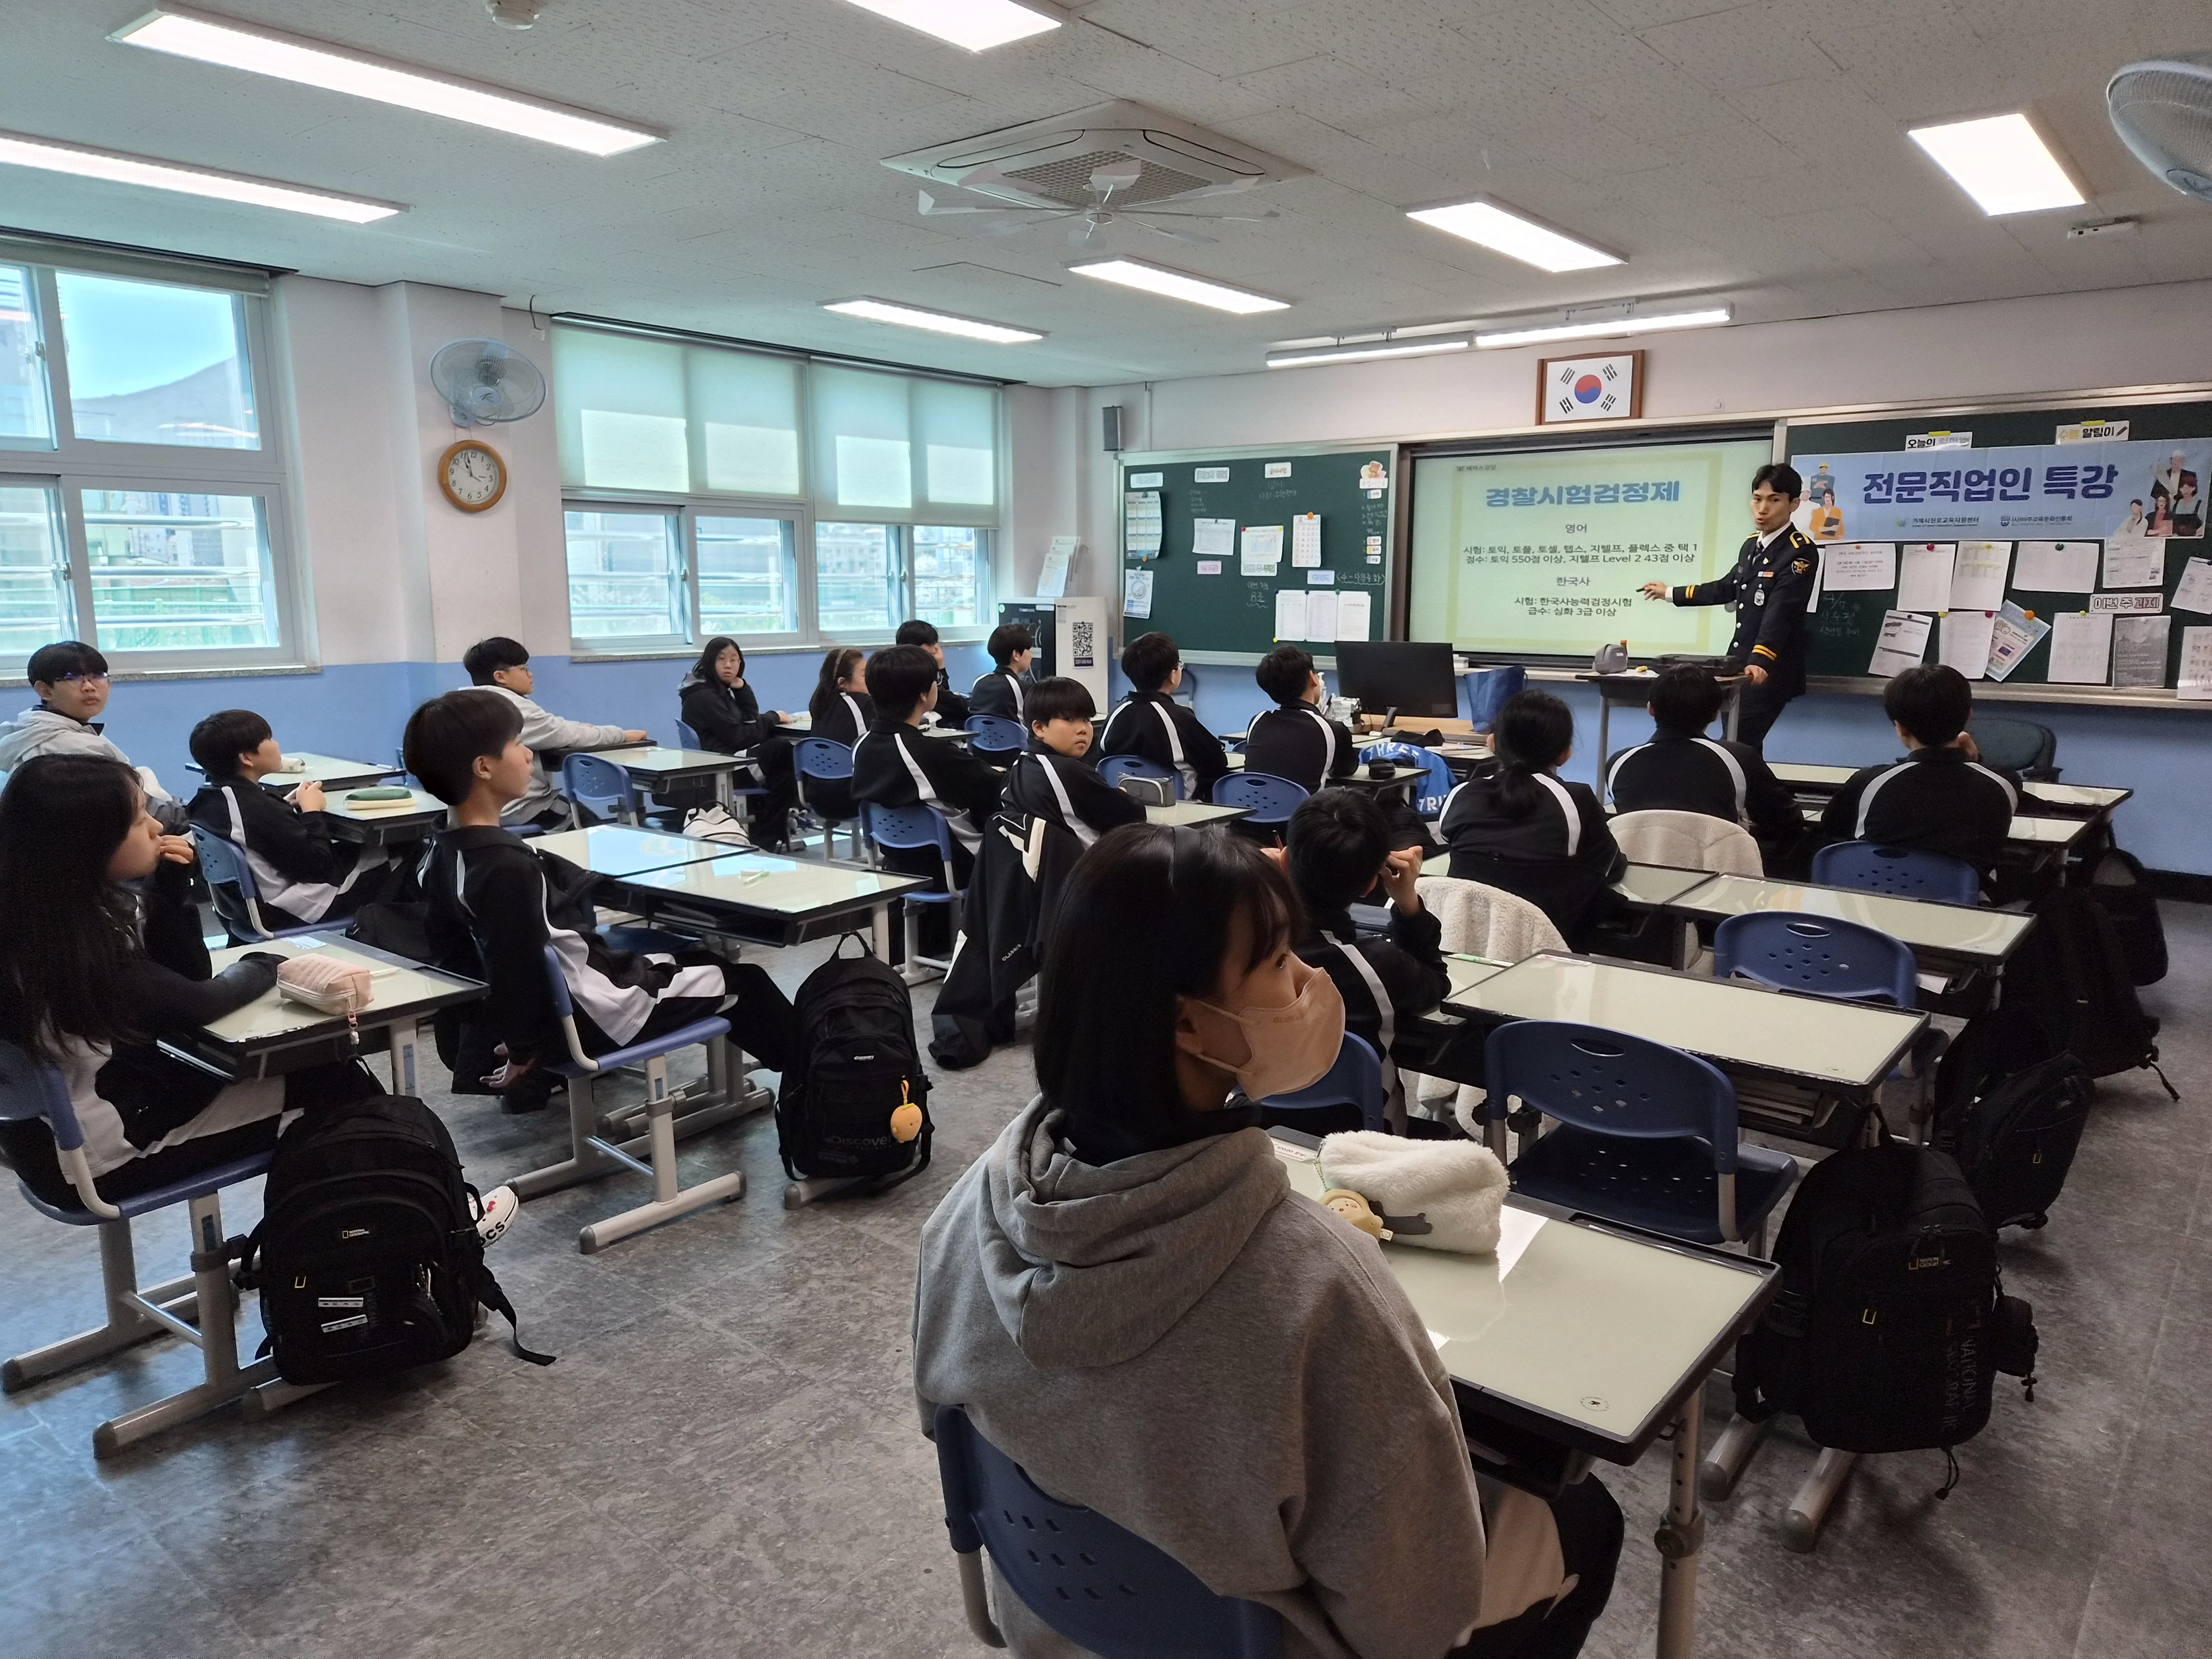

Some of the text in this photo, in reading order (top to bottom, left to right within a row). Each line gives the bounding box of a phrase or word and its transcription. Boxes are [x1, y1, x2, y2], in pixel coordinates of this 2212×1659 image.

[2082, 426, 2114, 439] 알림이
[1907, 438, 1936, 448] 오늘의
[1863, 463, 2119, 504] 전문직업인 특강
[1486, 481, 1680, 507] 경찰시험검정제
[1565, 524, 1587, 534] 영어
[1464, 546, 1485, 555] 시험:
[1488, 546, 1509, 554] 토익,
[1512, 546, 1534, 554] 토플,
[1537, 545, 1560, 554] 토셀,
[1590, 544, 1624, 553] 지텔프,
[1627, 544, 1660, 553] 플렉스
[1678, 543, 1688, 552] 택
[1467, 556, 1488, 564] 점수:
[1511, 555, 1540, 564] 550점
[1569, 555, 1600, 563] 지텔프
[1644, 554, 1669, 563] 43점
[1672, 554, 1695, 562] 이상
[1556, 577, 1590, 586] 한국사
[1514, 597, 1632, 607] 시험: 한국사능력검정시험
[2094, 597, 2159, 609] 이번 주 과제
[1528, 607, 1617, 617] 급수: 심화 3급 이상
[1418, 794, 1447, 812] TRI
